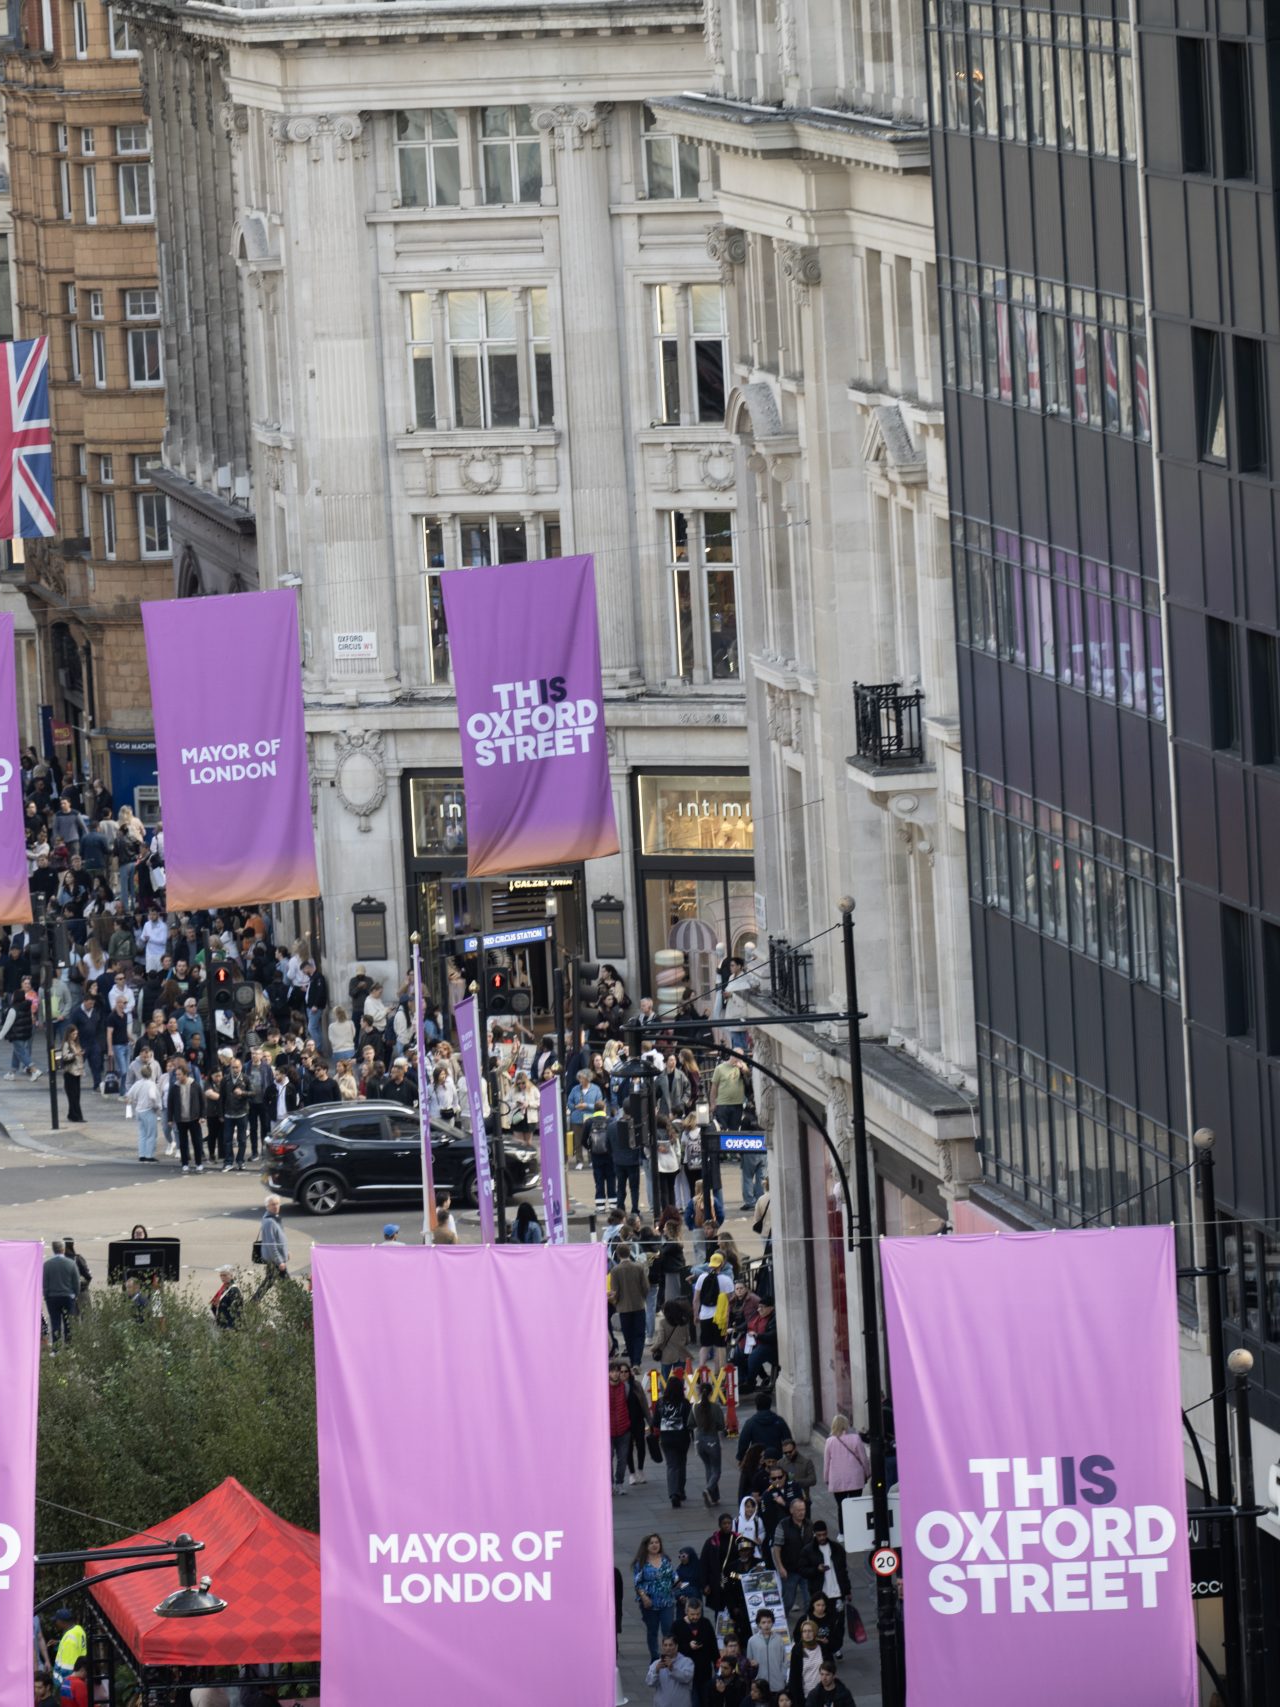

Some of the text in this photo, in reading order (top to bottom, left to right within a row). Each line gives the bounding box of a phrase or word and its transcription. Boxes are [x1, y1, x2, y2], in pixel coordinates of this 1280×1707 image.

[493, 675, 567, 709] THIS
[467, 700, 597, 739] OXFORD
[182, 739, 280, 764] MAYOR OF
[476, 726, 594, 765] STREET
[191, 761, 276, 784] LONDON
[495, 933, 517, 944] CIRCUS
[517, 930, 542, 940] STATION
[725, 1138, 763, 1149] OXFORD
[969, 1455, 1116, 1508] THIS
[370, 1531, 563, 1564] MAYOR OF
[916, 1506, 1176, 1561] OXFORD
[877, 1556, 896, 1568] 20
[384, 1572, 551, 1604] LONDON
[929, 1558, 1167, 1615] STREET
[1190, 1580, 1224, 1595] ecc
